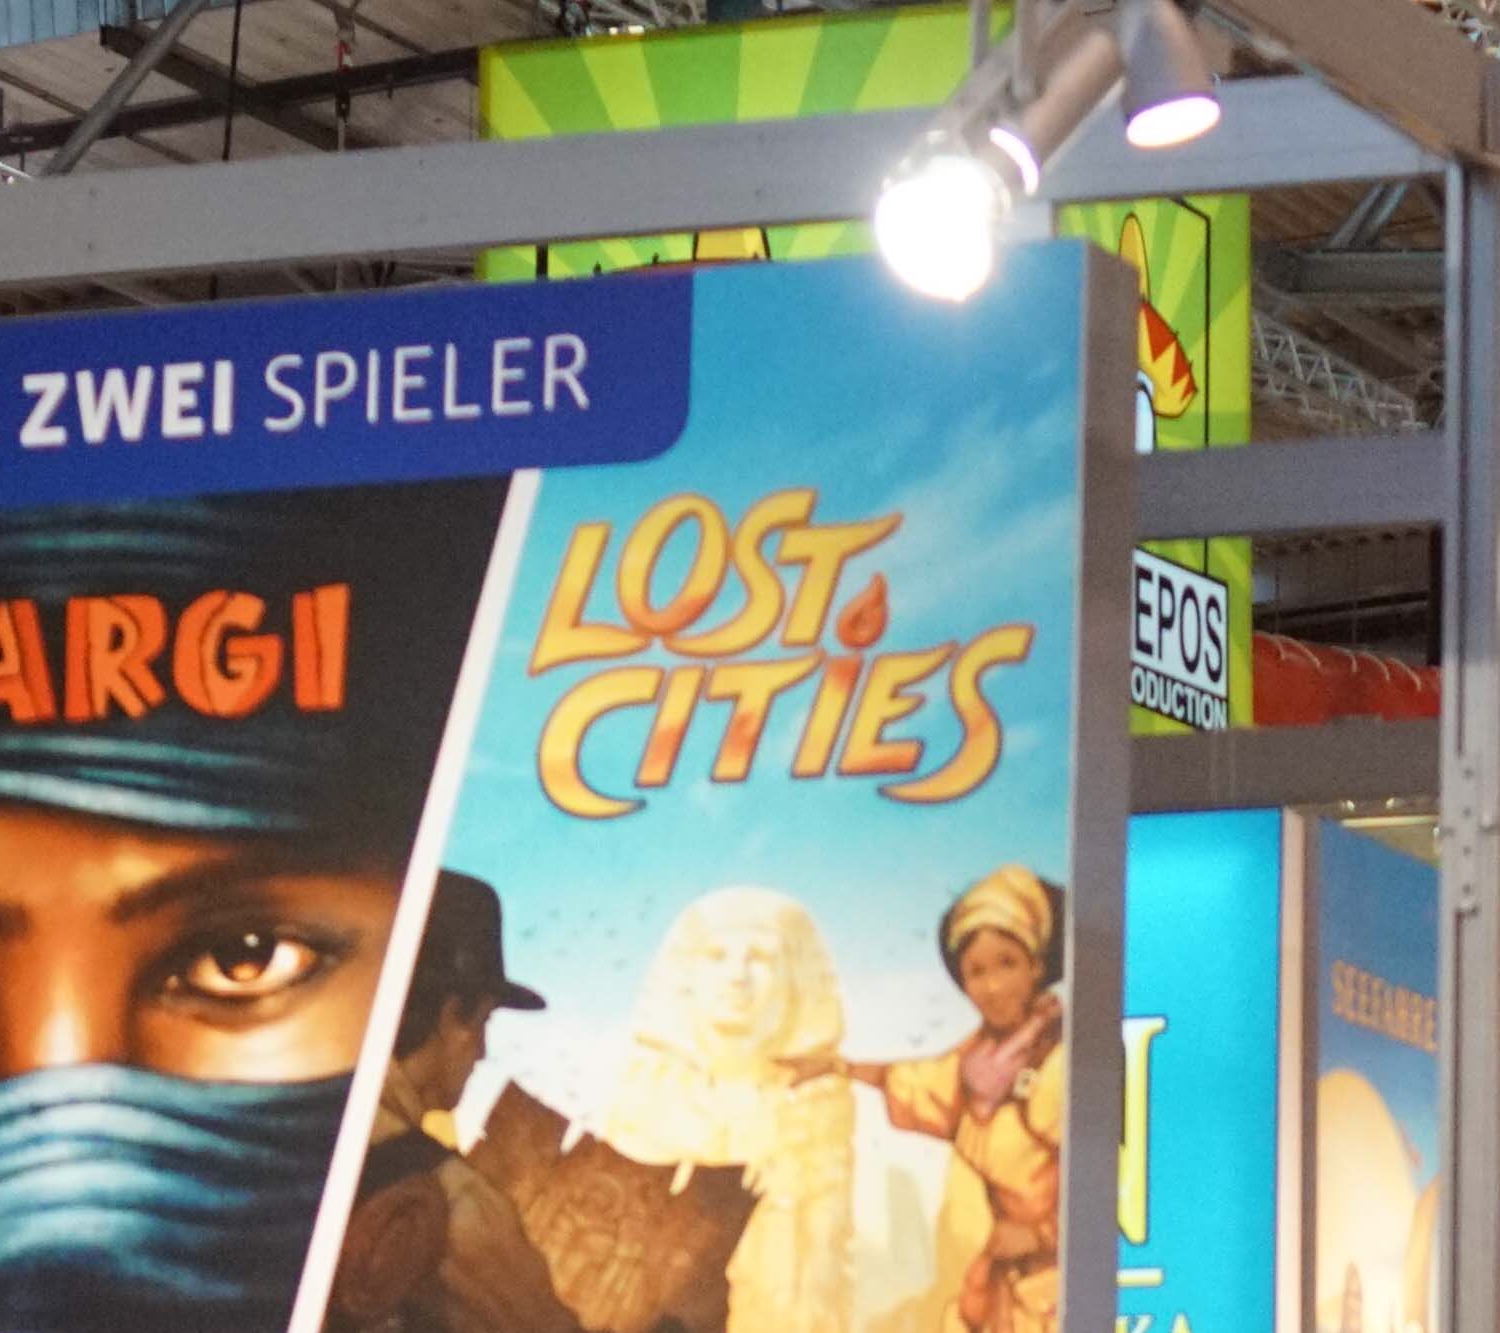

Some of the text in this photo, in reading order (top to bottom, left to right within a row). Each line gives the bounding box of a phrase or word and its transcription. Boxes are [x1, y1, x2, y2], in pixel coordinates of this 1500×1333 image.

[17, 361, 235, 448] ZWEI
[263, 331, 592, 433] SPIELER
[528, 486, 906, 676] LOST
[1134, 564, 1223, 684] EPOS
[534, 618, 1037, 822] CITIES
[1130, 663, 1228, 732] ODUCTION
